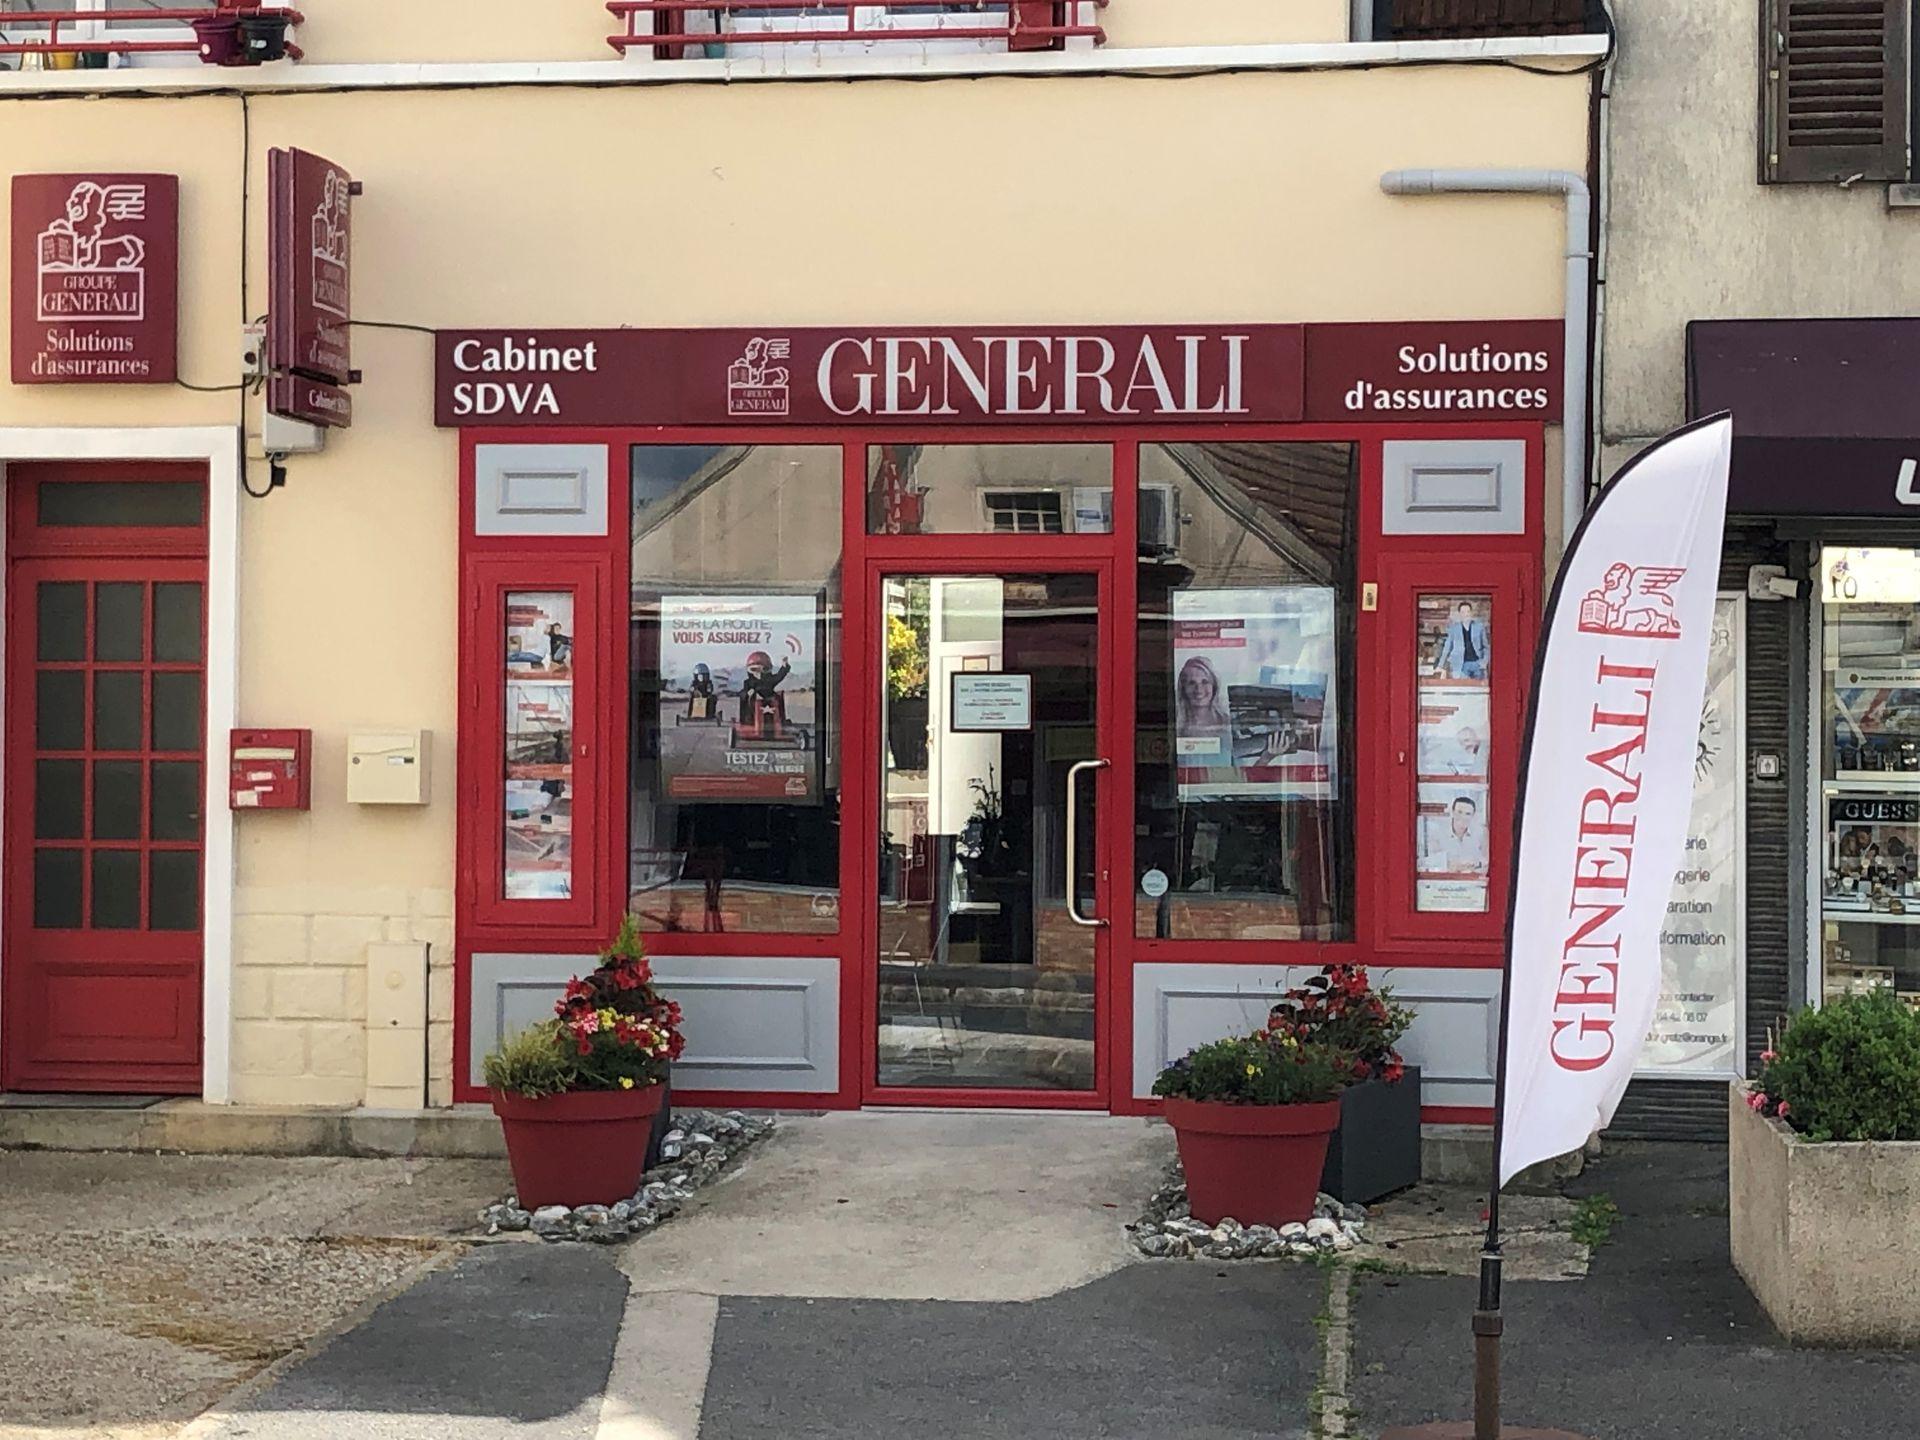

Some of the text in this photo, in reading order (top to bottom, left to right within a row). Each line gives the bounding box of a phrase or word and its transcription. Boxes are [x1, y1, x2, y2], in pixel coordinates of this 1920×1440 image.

[63, 275, 117, 290] GROUPE
[42, 291, 138, 312] GENERALI
[46, 329, 134, 352] Solutions
[31, 352, 150, 376] d'assurances
[453, 337, 598, 372] Cabinet
[1398, 343, 1549, 373] Solutions
[817, 334, 1250, 416] GENERALI
[453, 383, 560, 415] SDVA
[731, 399, 786, 410] GENERALI
[1344, 381, 1549, 410] d'assurances
[672, 618, 701, 630] SUR
[702, 618, 720, 630] LA
[672, 631, 772, 644] VOUS ASSUREZ ?
[725, 751, 769, 764] TESTEZ
[1845, 802, 1916, 819] GUESS
[1548, 654, 1659, 1073] GENERALI
[1674, 867, 1711, 885] gerie
[1666, 899, 1713, 914] aration
[1660, 929, 1726, 946] formation
